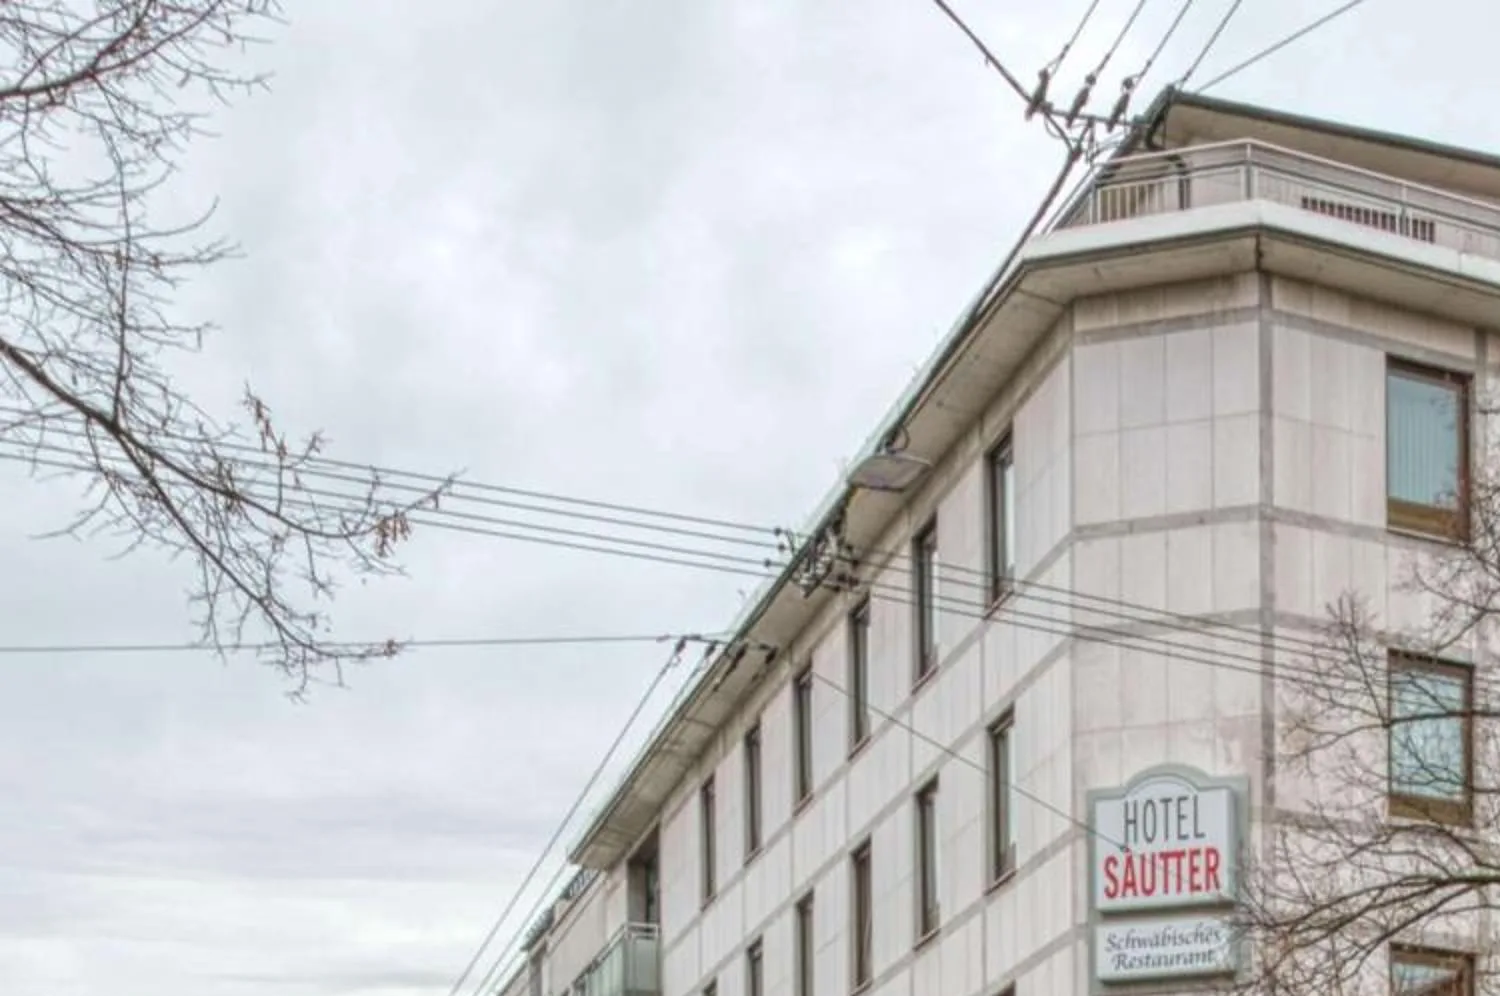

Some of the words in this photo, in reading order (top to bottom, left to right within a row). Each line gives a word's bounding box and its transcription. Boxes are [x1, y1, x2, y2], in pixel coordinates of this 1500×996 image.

[1123, 794, 1206, 845] HOTEL
[1103, 847, 1220, 899] SAUTTER
[1111, 949, 1216, 971] Restaurant
